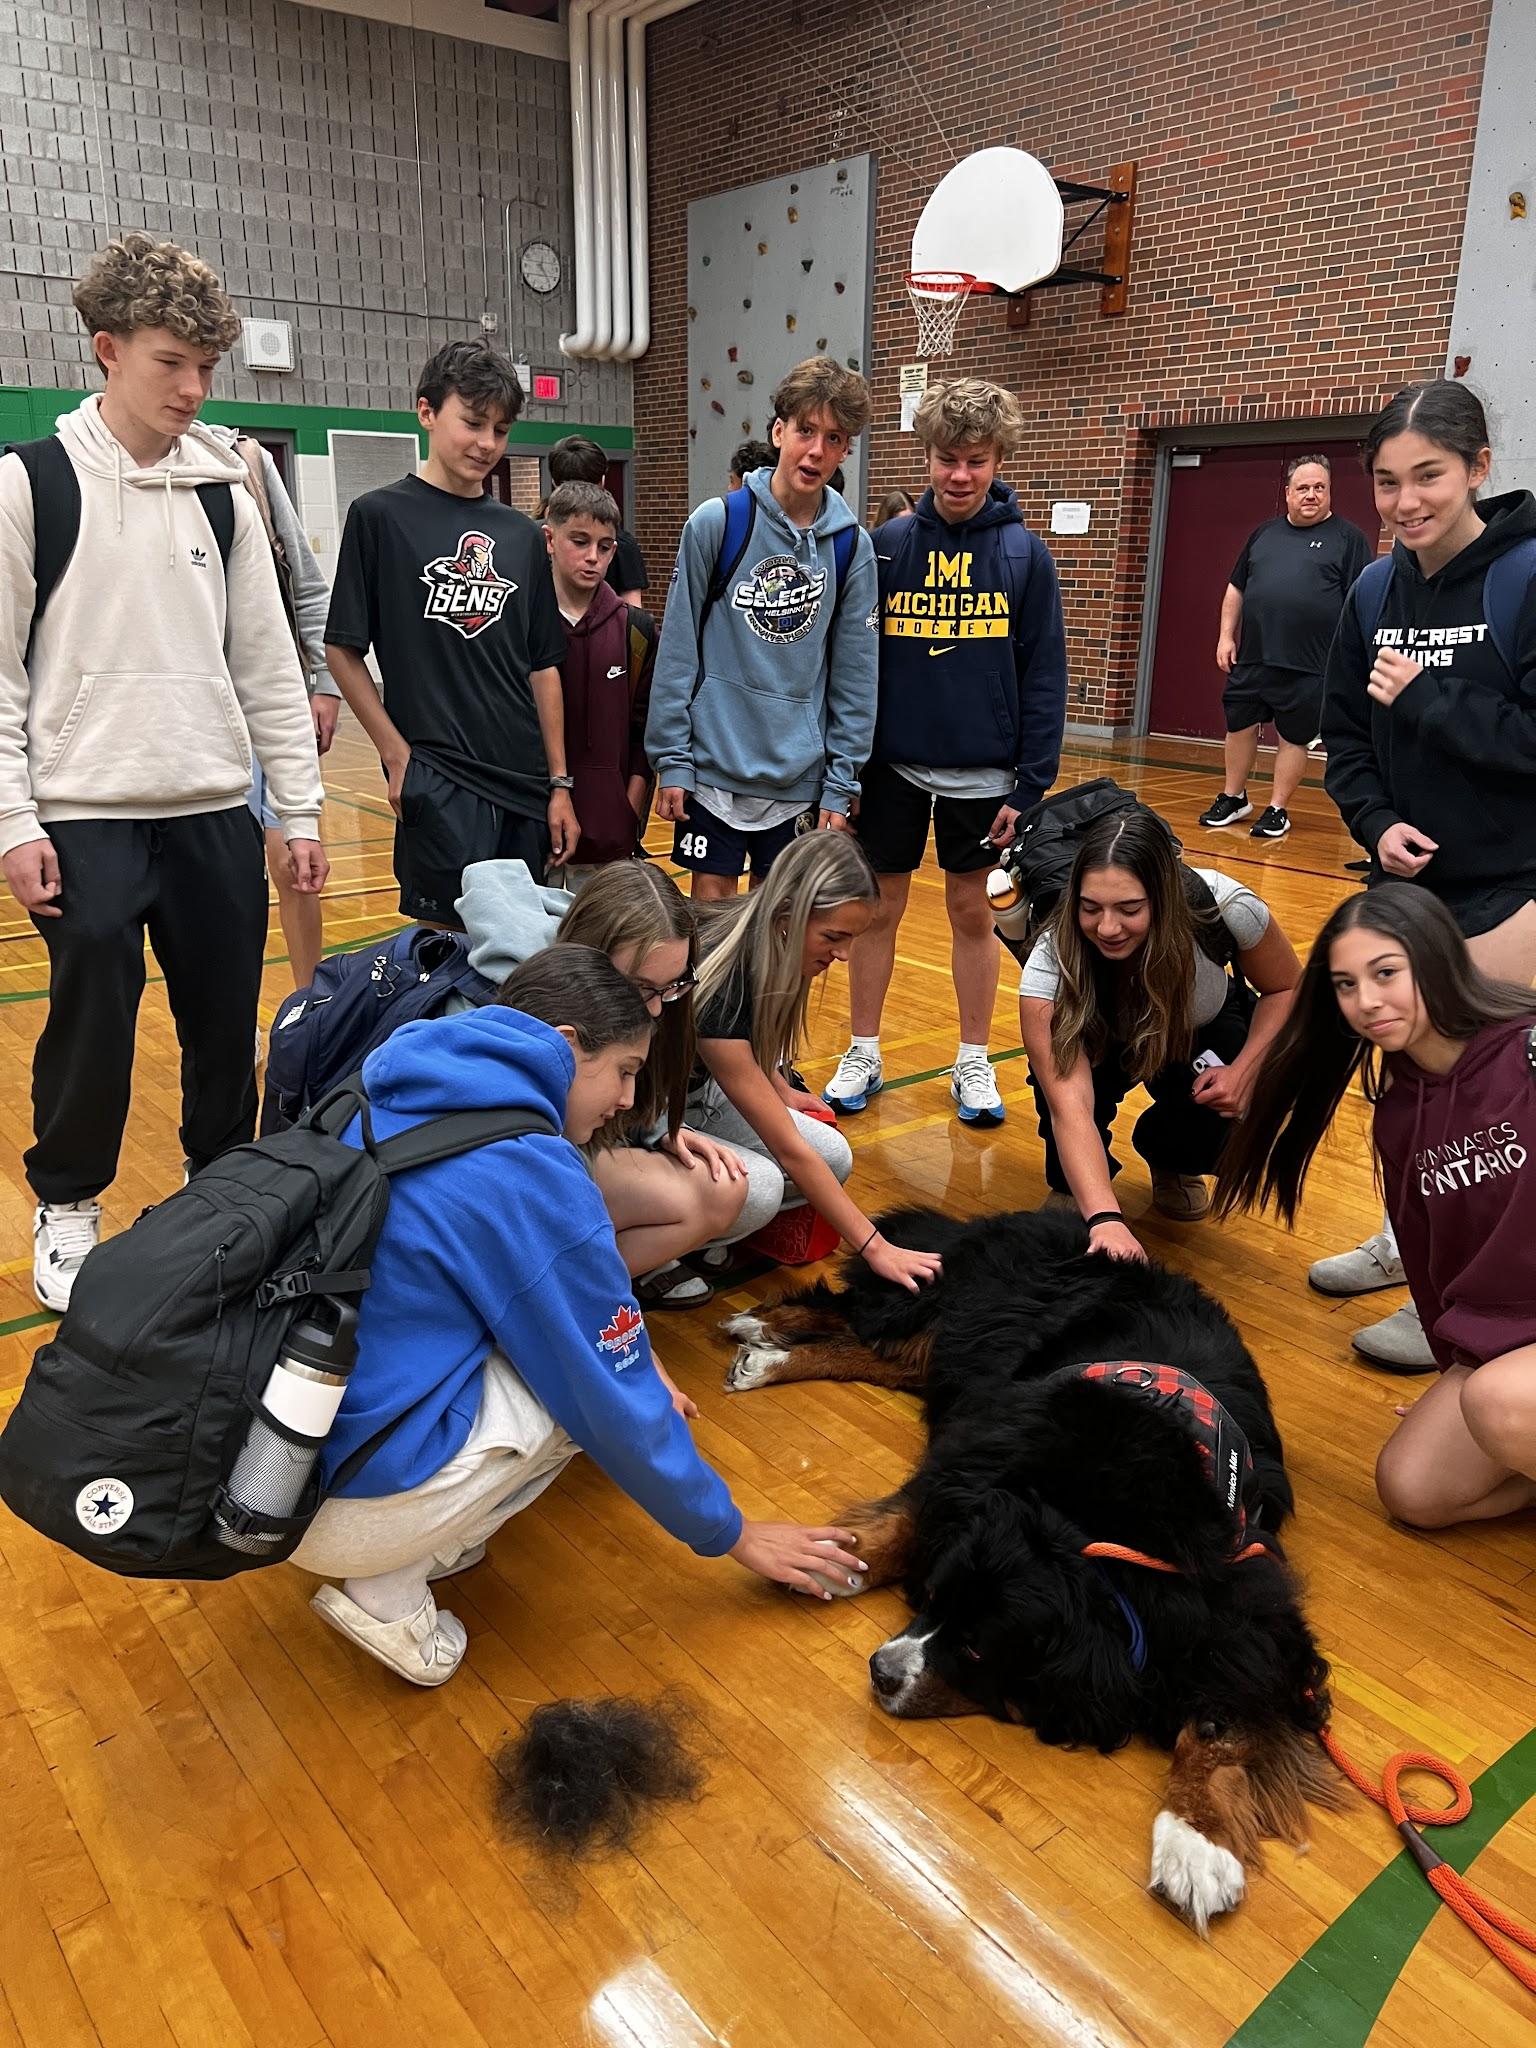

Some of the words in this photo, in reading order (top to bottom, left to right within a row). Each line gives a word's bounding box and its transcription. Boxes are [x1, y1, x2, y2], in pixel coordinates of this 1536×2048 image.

[754, 557, 797, 577] WORLD
[924, 551, 973, 588] M
[431, 583, 505, 613] SENS
[735, 572, 825, 608] SELECTS
[764, 605, 804, 617] HELSINKI
[884, 591, 1010, 617] MICHIGAN
[897, 620, 993, 637] HOCKEY
[679, 832, 708, 859] 48
[1415, 1121, 1518, 1171] GYMNASTICS
[1420, 1143, 1527, 1196] ONTARIO
[86, 1483, 127, 1501] CONVERSE
